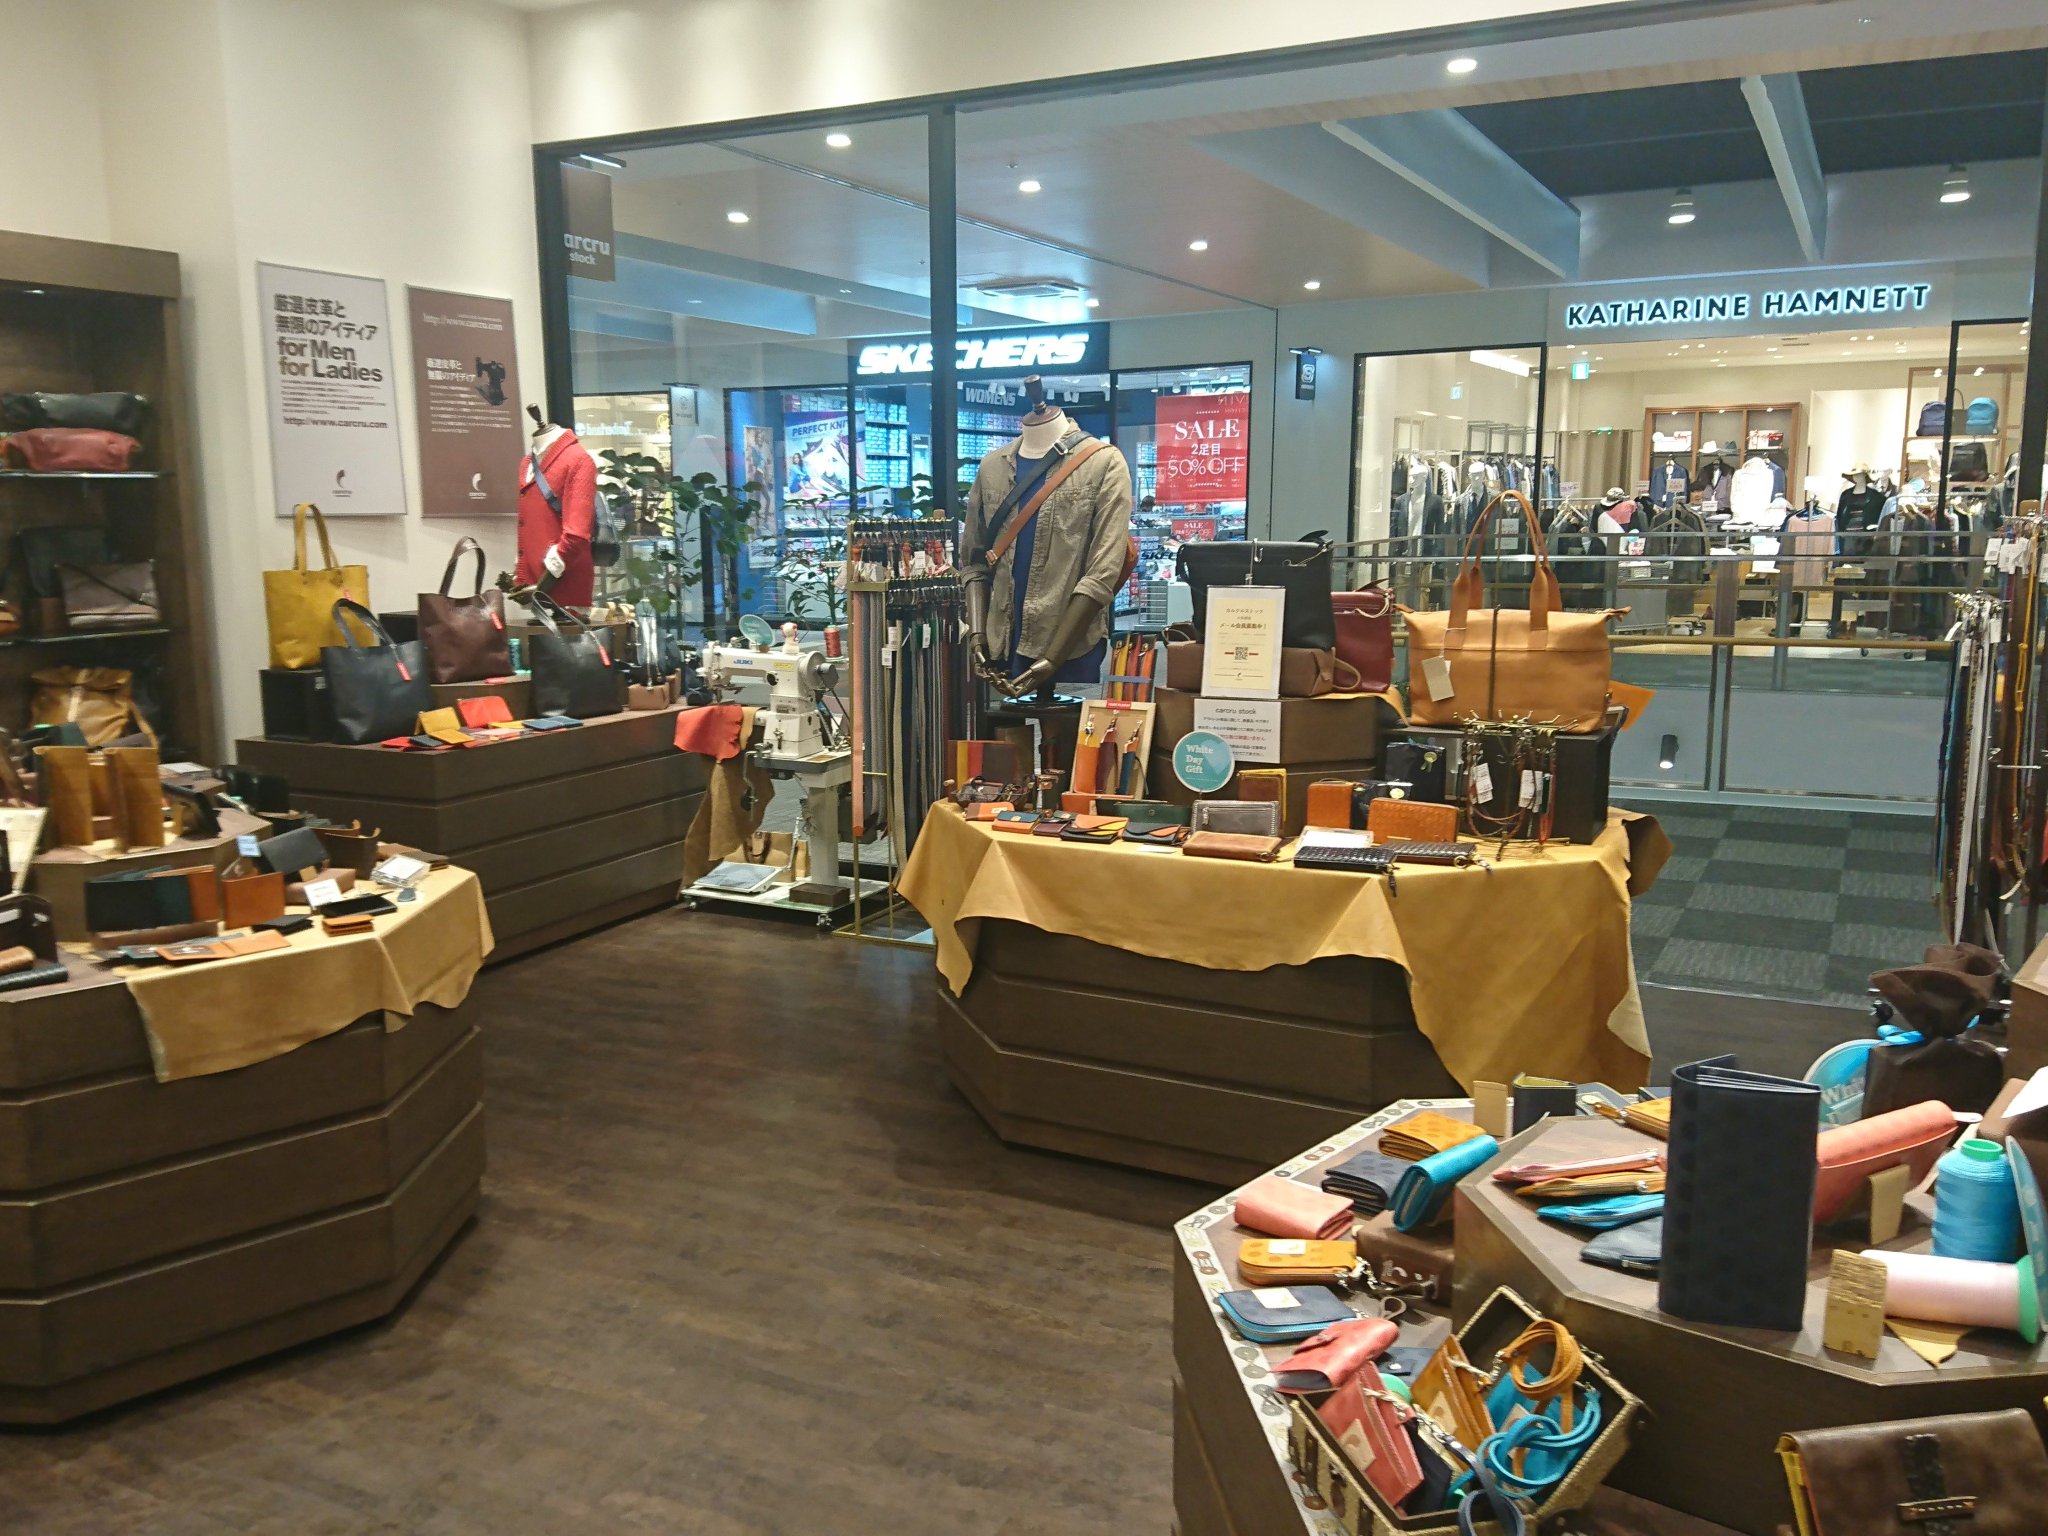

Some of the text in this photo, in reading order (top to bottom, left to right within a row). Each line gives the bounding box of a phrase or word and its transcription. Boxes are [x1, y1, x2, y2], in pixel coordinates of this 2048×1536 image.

[569, 251, 596, 265] stock
[1566, 284, 1931, 329] KATHARINE HAMNETT
[277, 336, 356, 361] for Men
[278, 356, 384, 383] for Ladies
[965, 387, 1016, 407] WOMENS
[791, 422, 828, 437] PERFECT
[1174, 418, 1241, 440] SALE
[1191, 443, 1221, 456] 2足目
[1185, 744, 1214, 754] White
[1185, 755, 1204, 765] Day
[1185, 765, 1204, 774] Gift
